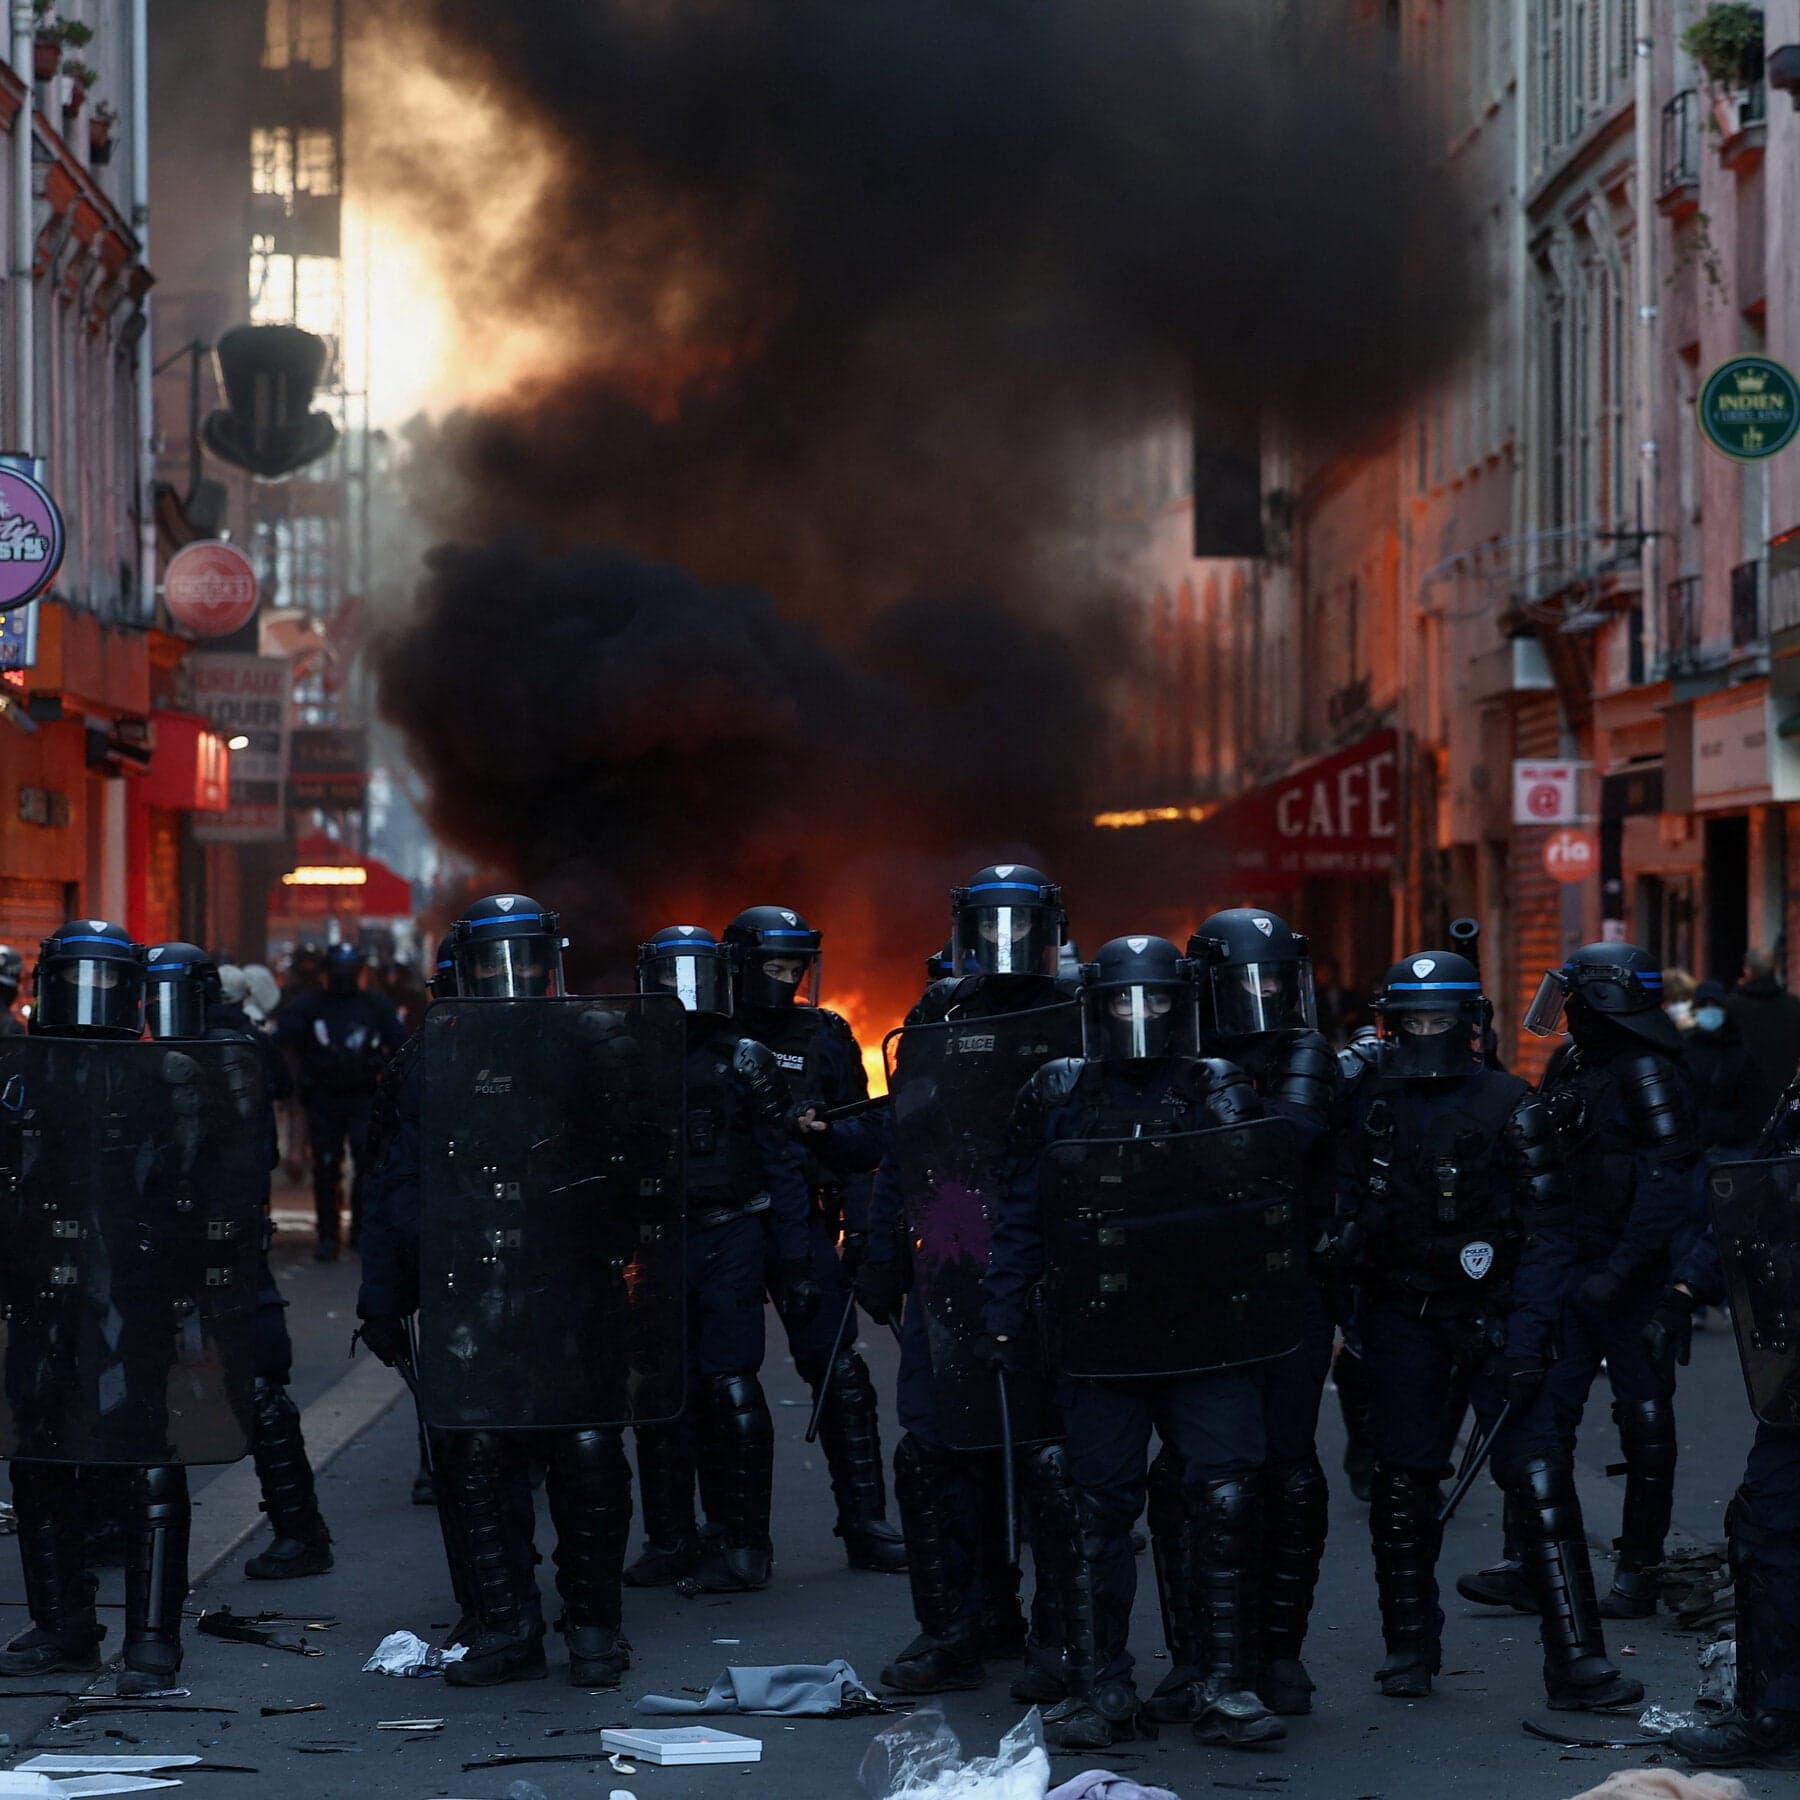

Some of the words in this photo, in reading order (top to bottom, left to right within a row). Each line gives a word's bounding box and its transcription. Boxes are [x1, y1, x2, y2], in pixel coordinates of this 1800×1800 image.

[1718, 393, 1784, 411] INDIEN
[1547, 834, 1590, 863] ria
[475, 1083, 512, 1094] POLICE
